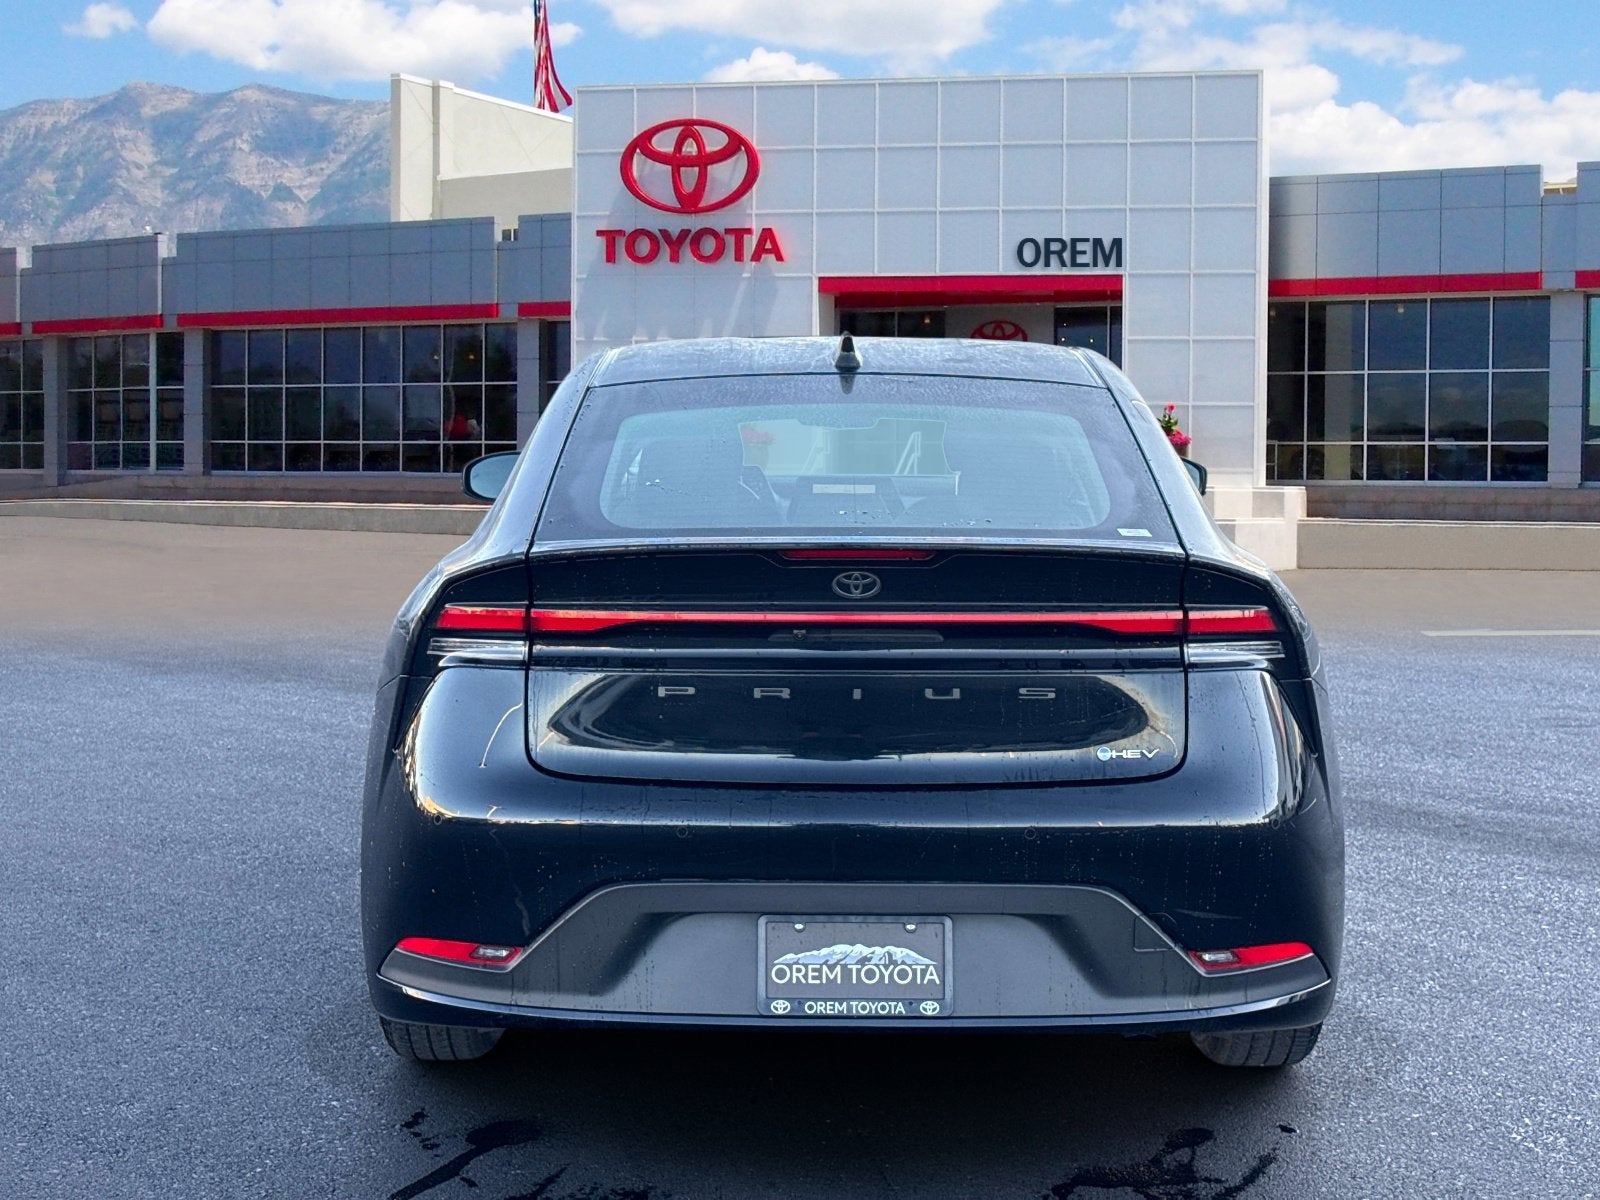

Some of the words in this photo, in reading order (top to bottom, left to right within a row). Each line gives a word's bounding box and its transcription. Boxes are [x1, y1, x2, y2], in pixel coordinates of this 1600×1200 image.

[596, 227, 785, 264] TOYOTA
[1017, 237, 1123, 268] OREM
[657, 686, 1057, 699] PRIUS
[1111, 748, 1160, 759] HEV
[771, 964, 841, 984] OREM
[847, 964, 940, 985] TOYOTA
[804, 1001, 847, 1014] OREM
[850, 1001, 905, 1015] TOYOTA
